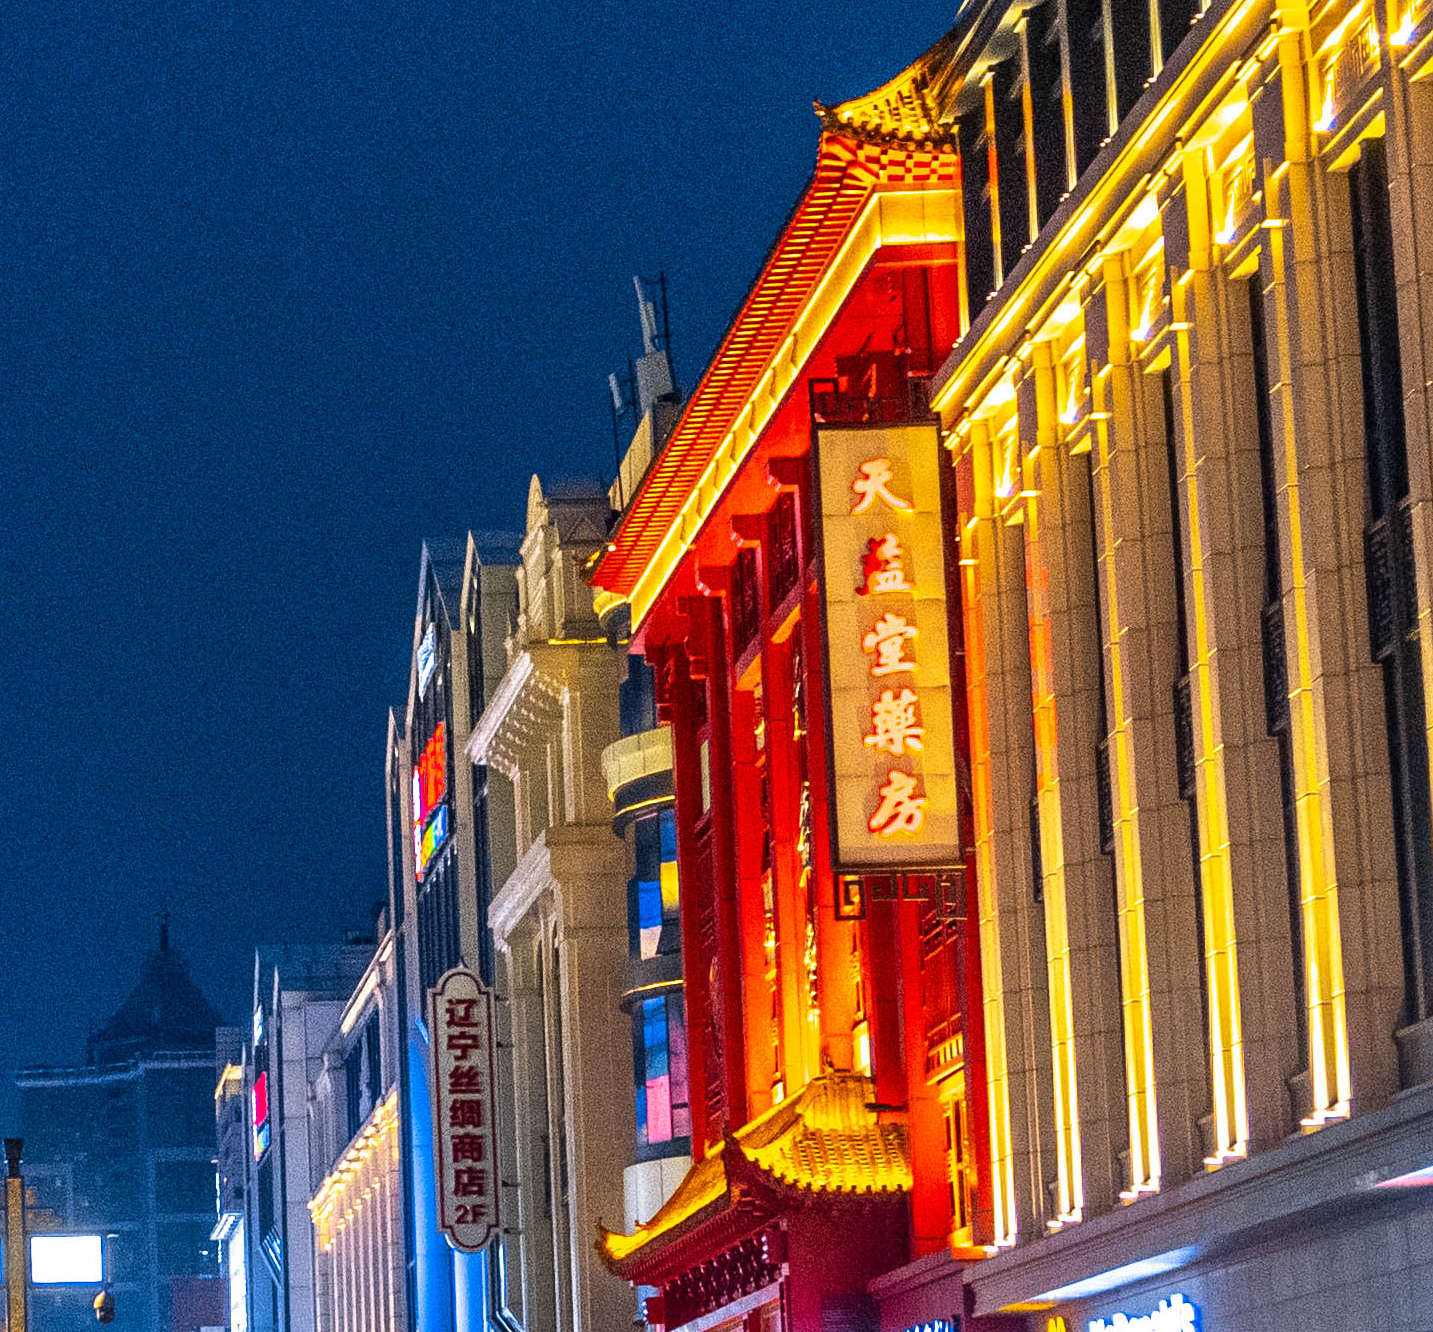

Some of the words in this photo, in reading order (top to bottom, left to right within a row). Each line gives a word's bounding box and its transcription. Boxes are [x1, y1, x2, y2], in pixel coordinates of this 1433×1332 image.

[445, 998, 487, 1197] 辽宁丝绸商店
[454, 1203, 486, 1225] 2F
